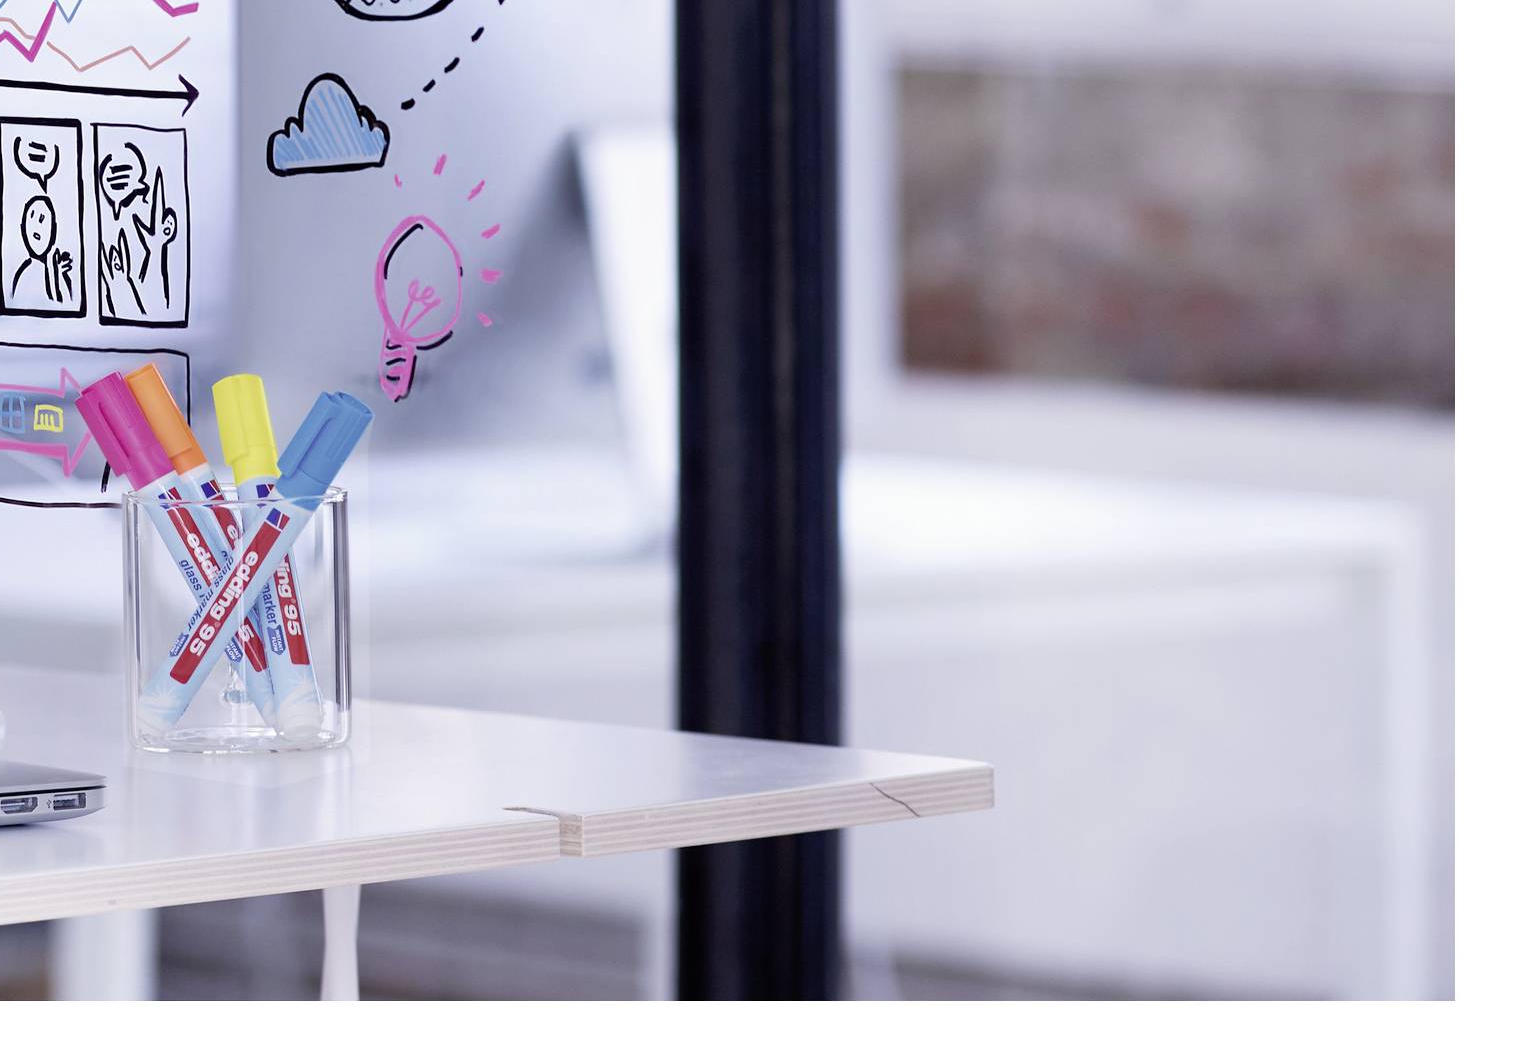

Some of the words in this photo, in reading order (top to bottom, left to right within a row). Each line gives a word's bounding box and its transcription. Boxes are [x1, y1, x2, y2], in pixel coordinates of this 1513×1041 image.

[179, 559, 203, 591] glass
[210, 551, 259, 621] edding
[214, 554, 235, 587] glass
[187, 589, 214, 632] marker
[284, 605, 302, 636] 95
[189, 623, 216, 657] 95
